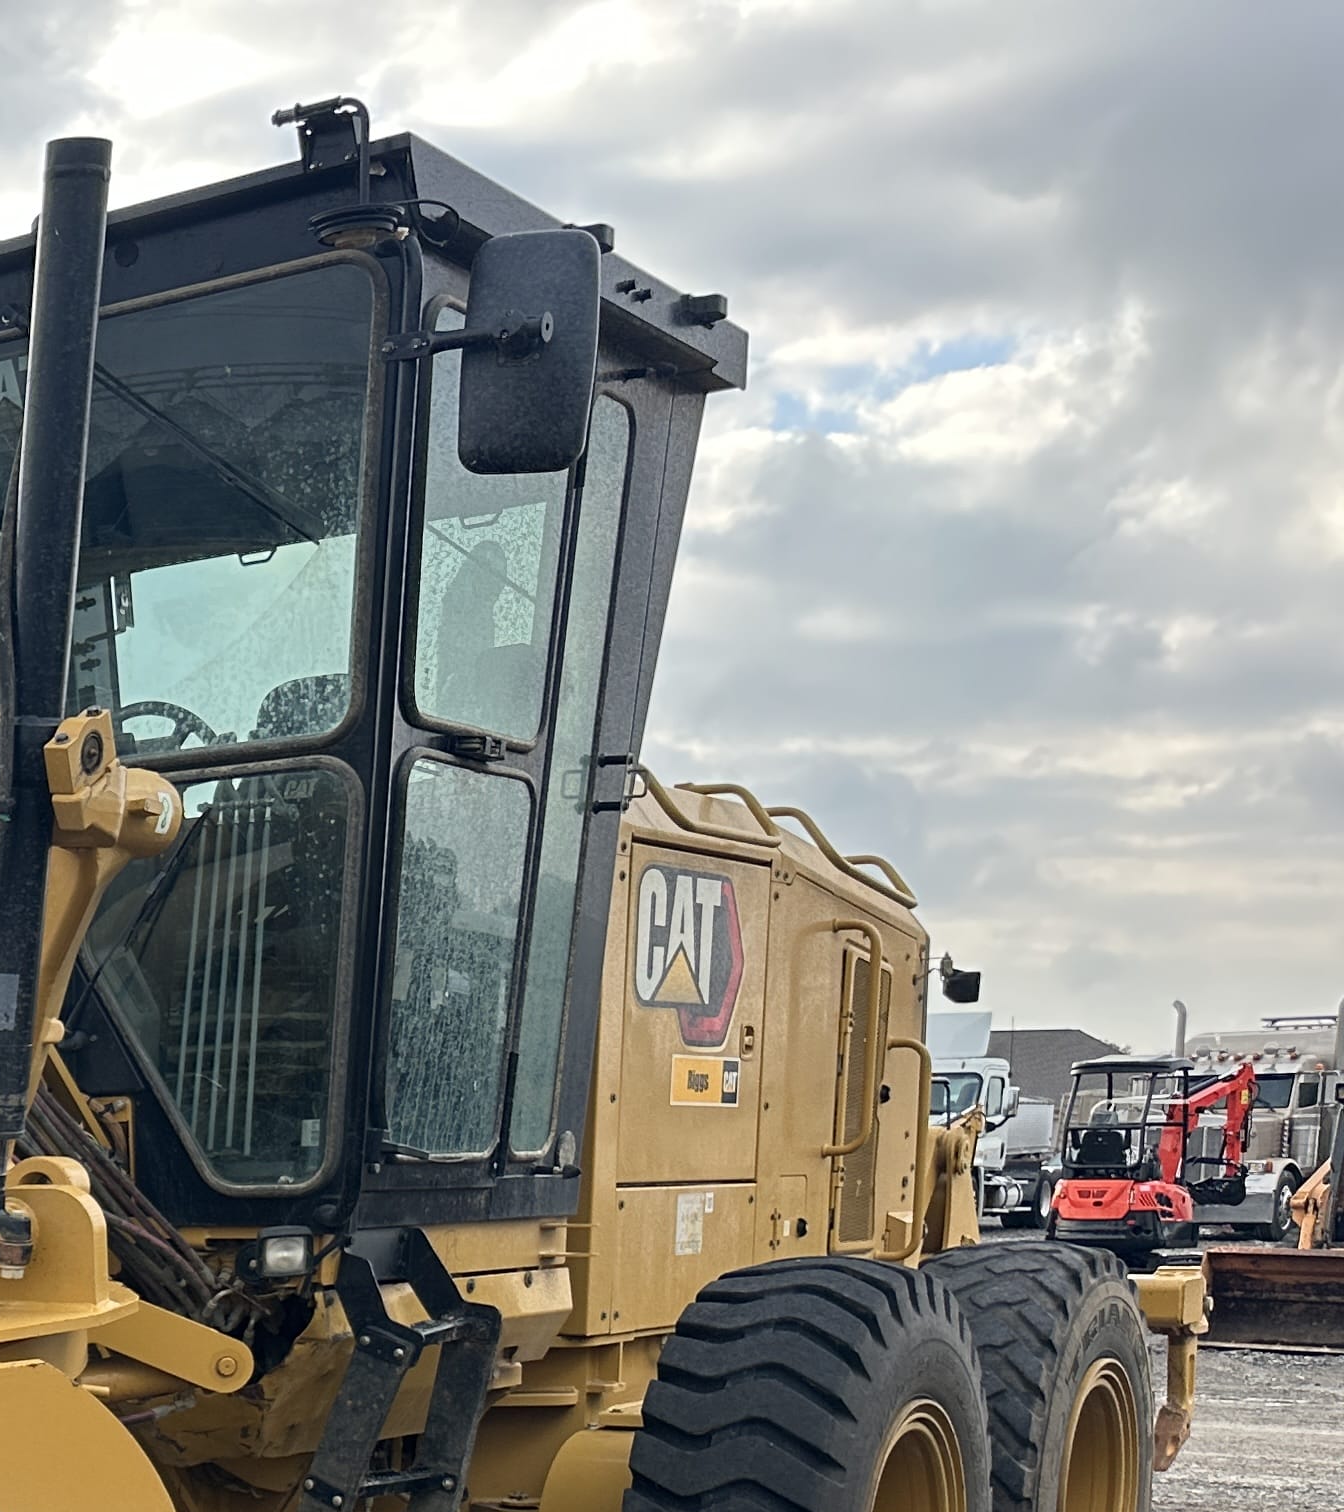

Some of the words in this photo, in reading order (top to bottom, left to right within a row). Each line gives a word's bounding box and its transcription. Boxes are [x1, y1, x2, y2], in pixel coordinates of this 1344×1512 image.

[636, 868, 722, 1005] CAT
[687, 1070, 709, 1091] Riggs
[723, 1071, 738, 1093] CAT
